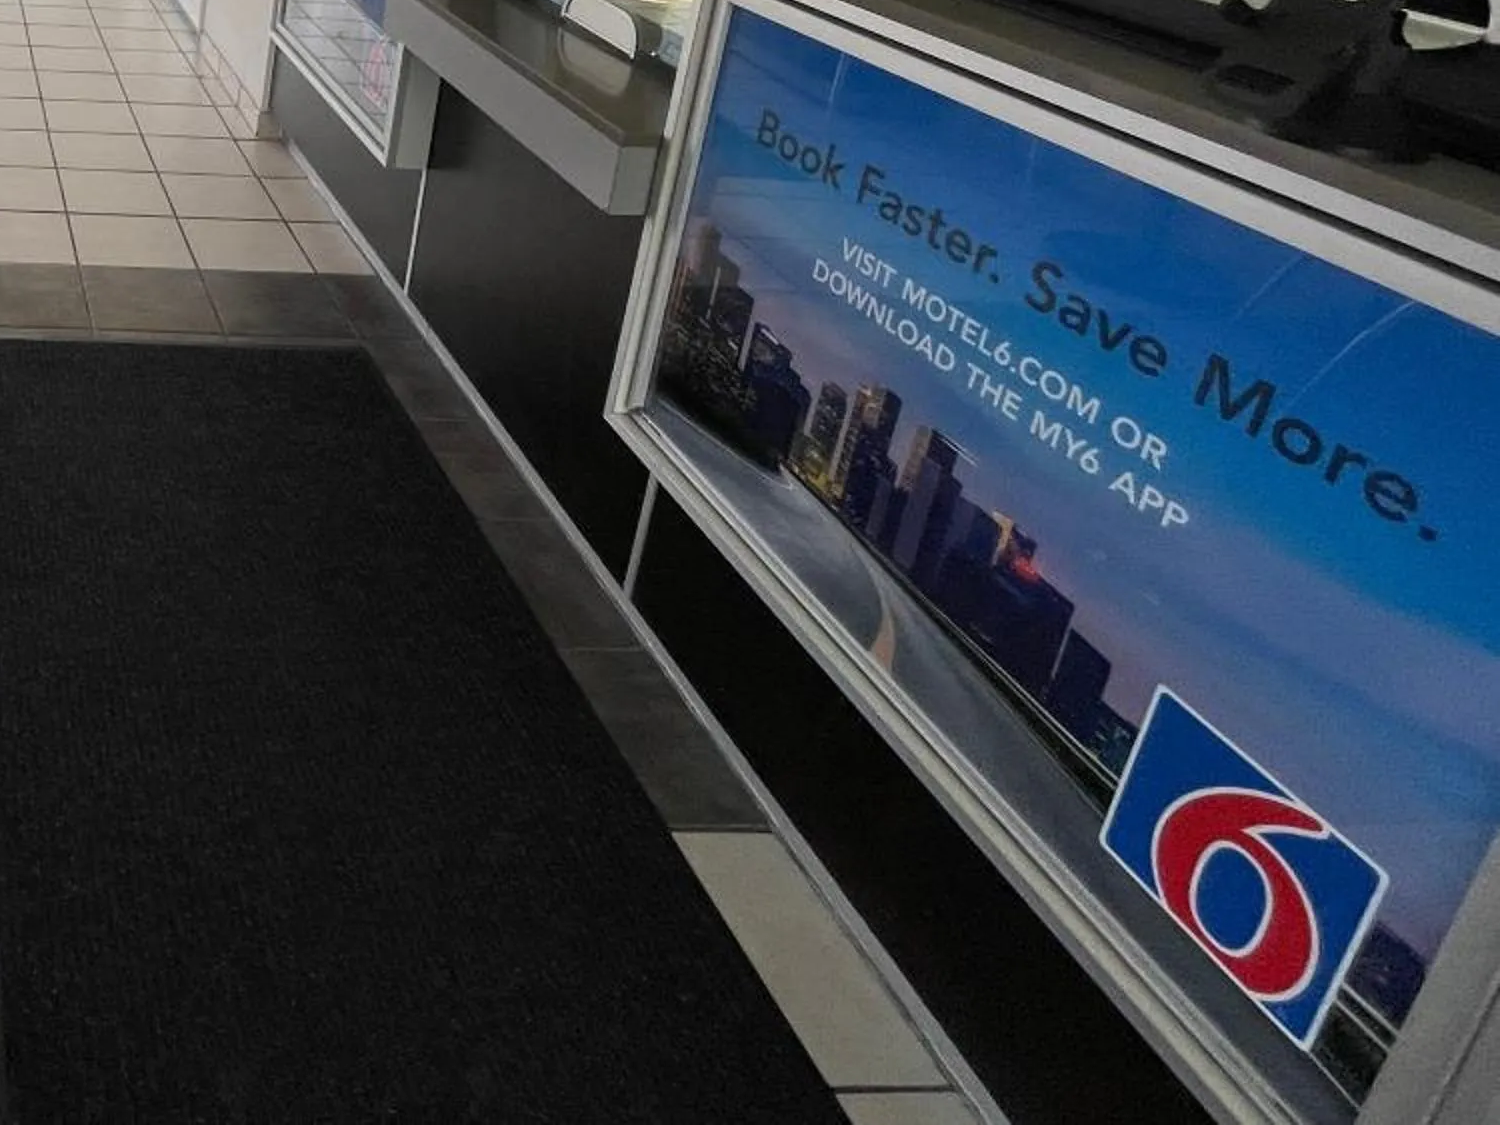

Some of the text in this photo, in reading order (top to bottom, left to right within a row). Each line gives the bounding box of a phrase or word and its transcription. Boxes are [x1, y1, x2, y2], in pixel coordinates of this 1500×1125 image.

[756, 108, 1438, 541] Book Faster. Save More.
[813, 258, 1189, 528] DOWNLOAD THE MY6 APP
[842, 236, 1168, 471] VISIT MOTEL6.COM OR
[1151, 786, 1333, 1002] 6
